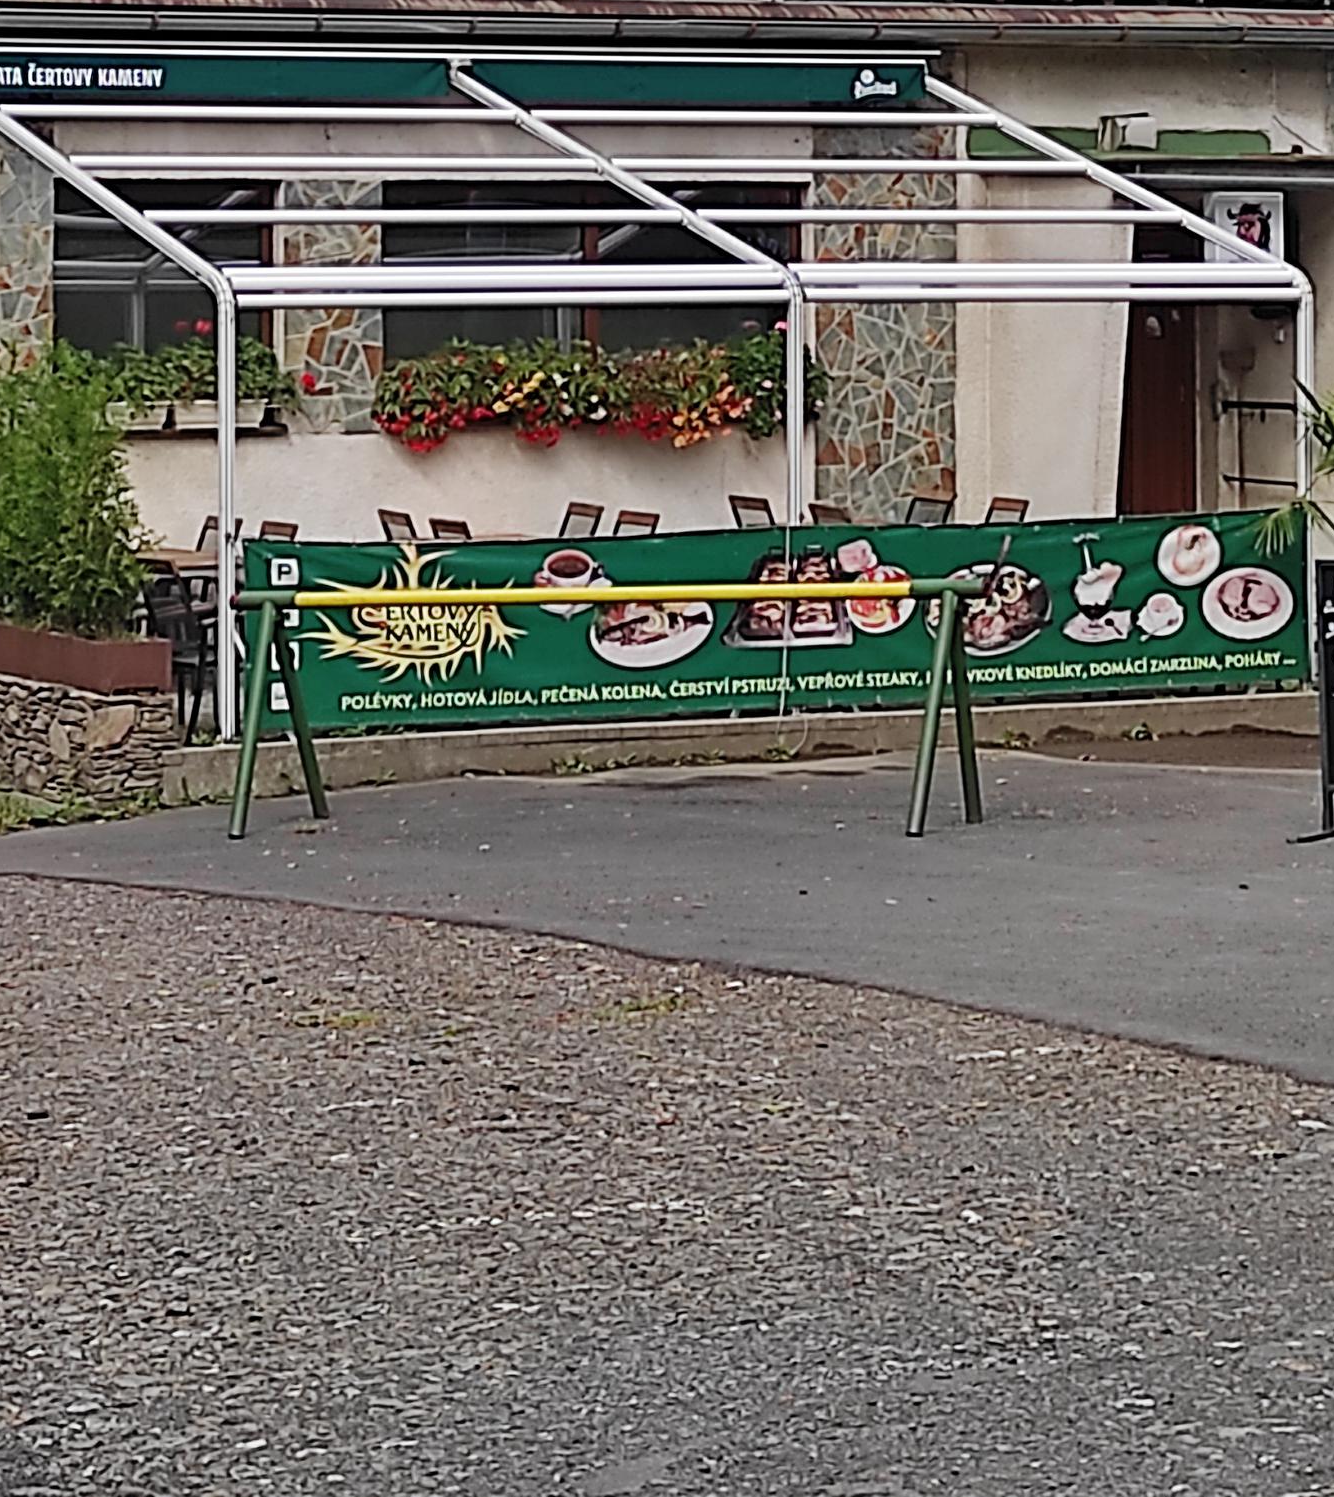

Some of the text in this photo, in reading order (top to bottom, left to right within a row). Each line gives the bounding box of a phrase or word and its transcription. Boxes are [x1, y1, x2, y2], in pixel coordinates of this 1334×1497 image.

[27, 62, 93, 87] ČERTOVY
[97, 67, 164, 87] KAMENY
[277, 563, 292, 582] P
[385, 621, 476, 644] KAMENY
[341, 689, 418, 712] POLÉVKY,
[420, 688, 487, 708] HOTOVÁ
[489, 687, 539, 707] JÍDLA,
[540, 682, 599, 704] PEČENÁ
[669, 675, 730, 697] ČERSTVÍ
[797, 669, 865, 690] VEPŘOVÉ
[866, 671, 924, 689] STEAKY,
[1015, 659, 1088, 683] KNEDLÍKY,
[1089, 656, 1147, 678] DOMÁCÍ
[1149, 655, 1223, 674] ZMRZLINA,
[1224, 649, 1281, 670] POHÁRY
